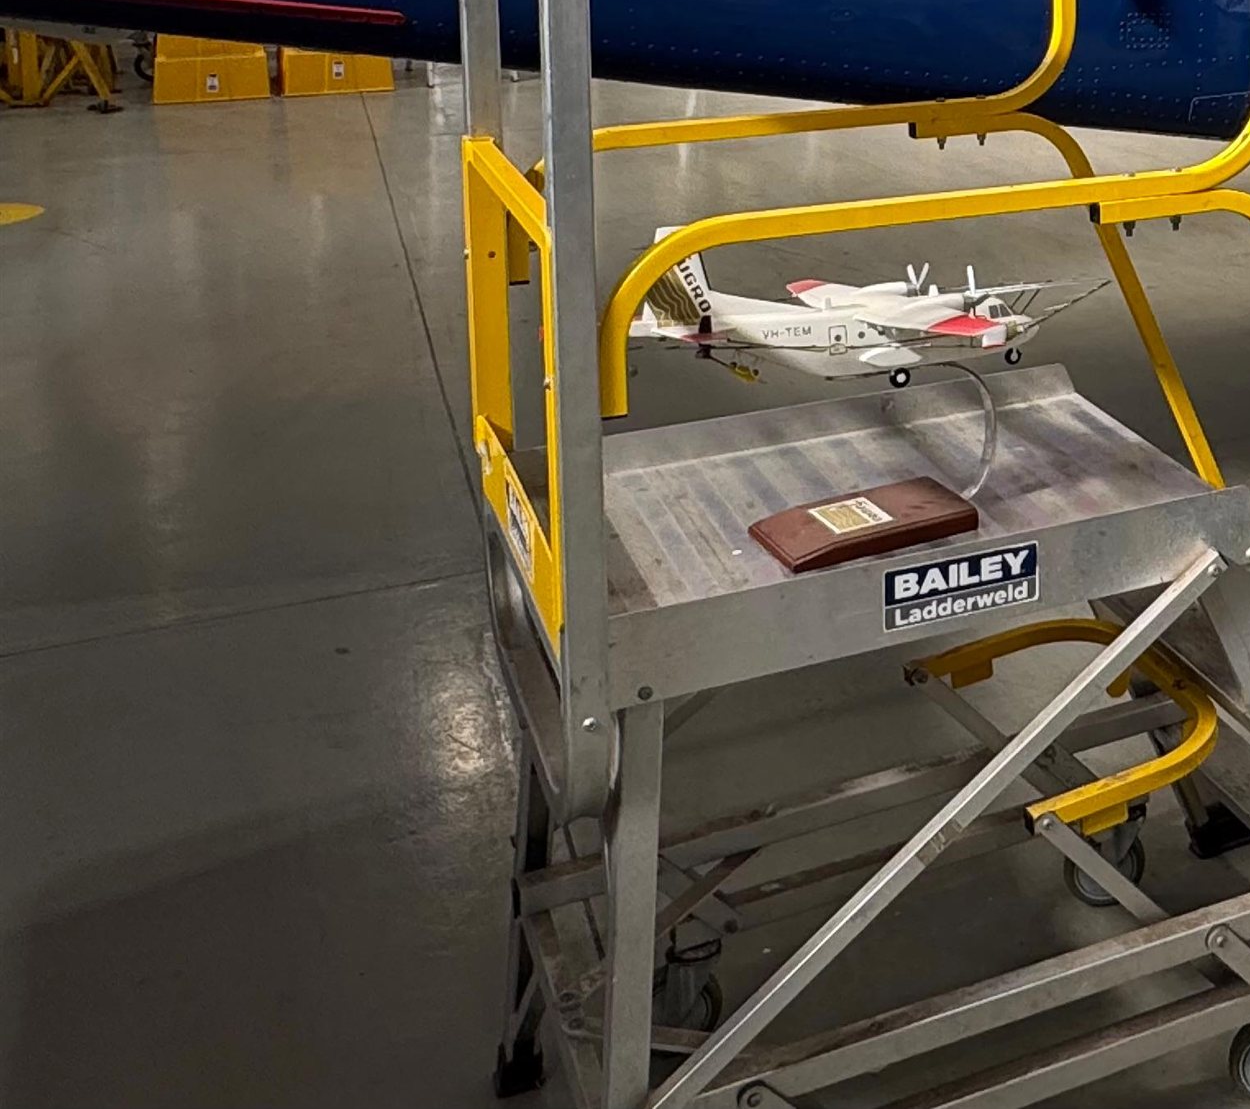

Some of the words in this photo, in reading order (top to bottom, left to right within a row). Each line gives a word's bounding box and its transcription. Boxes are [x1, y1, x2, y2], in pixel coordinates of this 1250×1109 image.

[677, 257, 711, 312] UGRO
[762, 326, 812, 340] VH-TEM
[894, 549, 1029, 600] BAILEY
[895, 581, 1029, 626] Ladderweld
